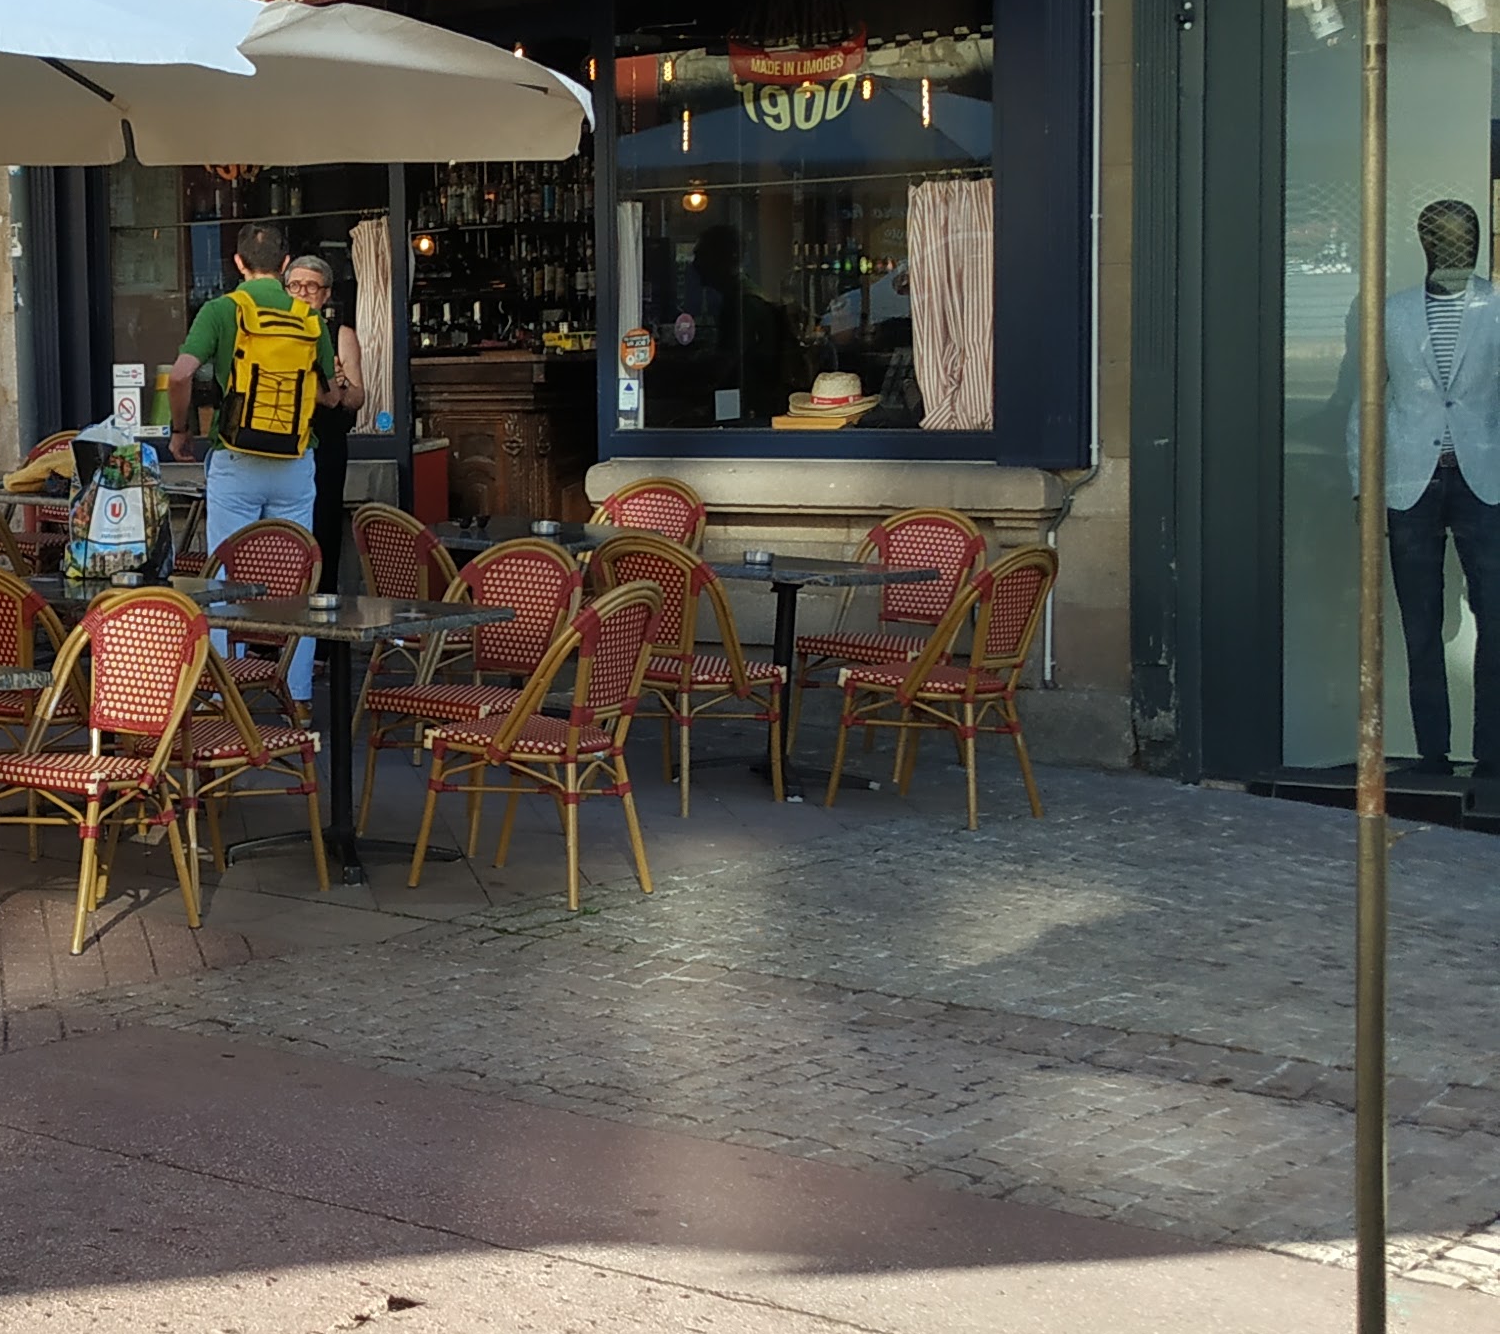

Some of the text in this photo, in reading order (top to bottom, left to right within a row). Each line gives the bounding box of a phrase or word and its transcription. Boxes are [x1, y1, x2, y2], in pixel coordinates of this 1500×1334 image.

[751, 53, 844, 75] MADE IN LIMOGES
[734, 74, 857, 131] 1900
[110, 502, 123, 518] U
